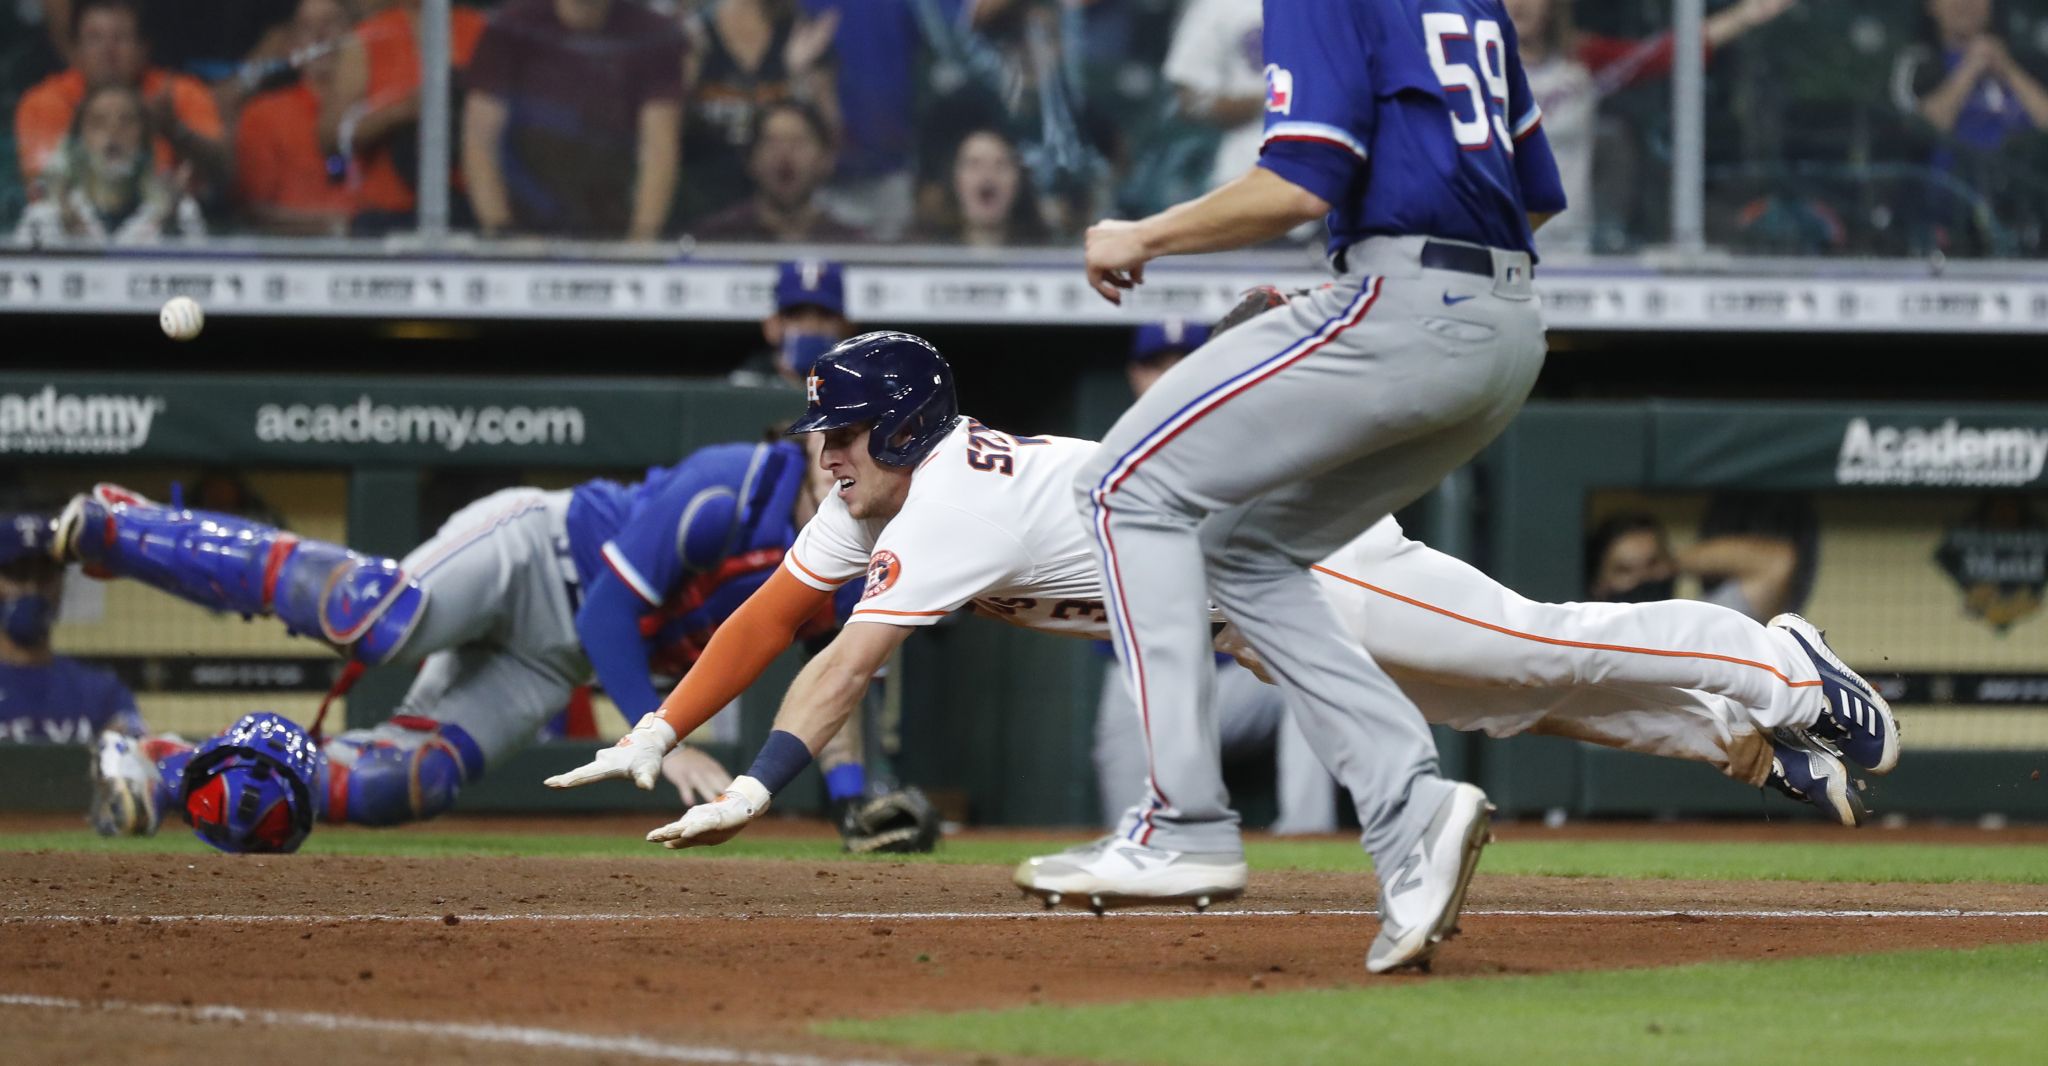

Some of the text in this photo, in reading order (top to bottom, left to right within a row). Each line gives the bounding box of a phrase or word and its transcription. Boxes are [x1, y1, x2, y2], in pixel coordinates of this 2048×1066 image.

[1421, 12, 1515, 155] 59
[0, 384, 155, 449] ademy
[255, 394, 585, 452] academy.com
[1838, 416, 2048, 482] Academy
